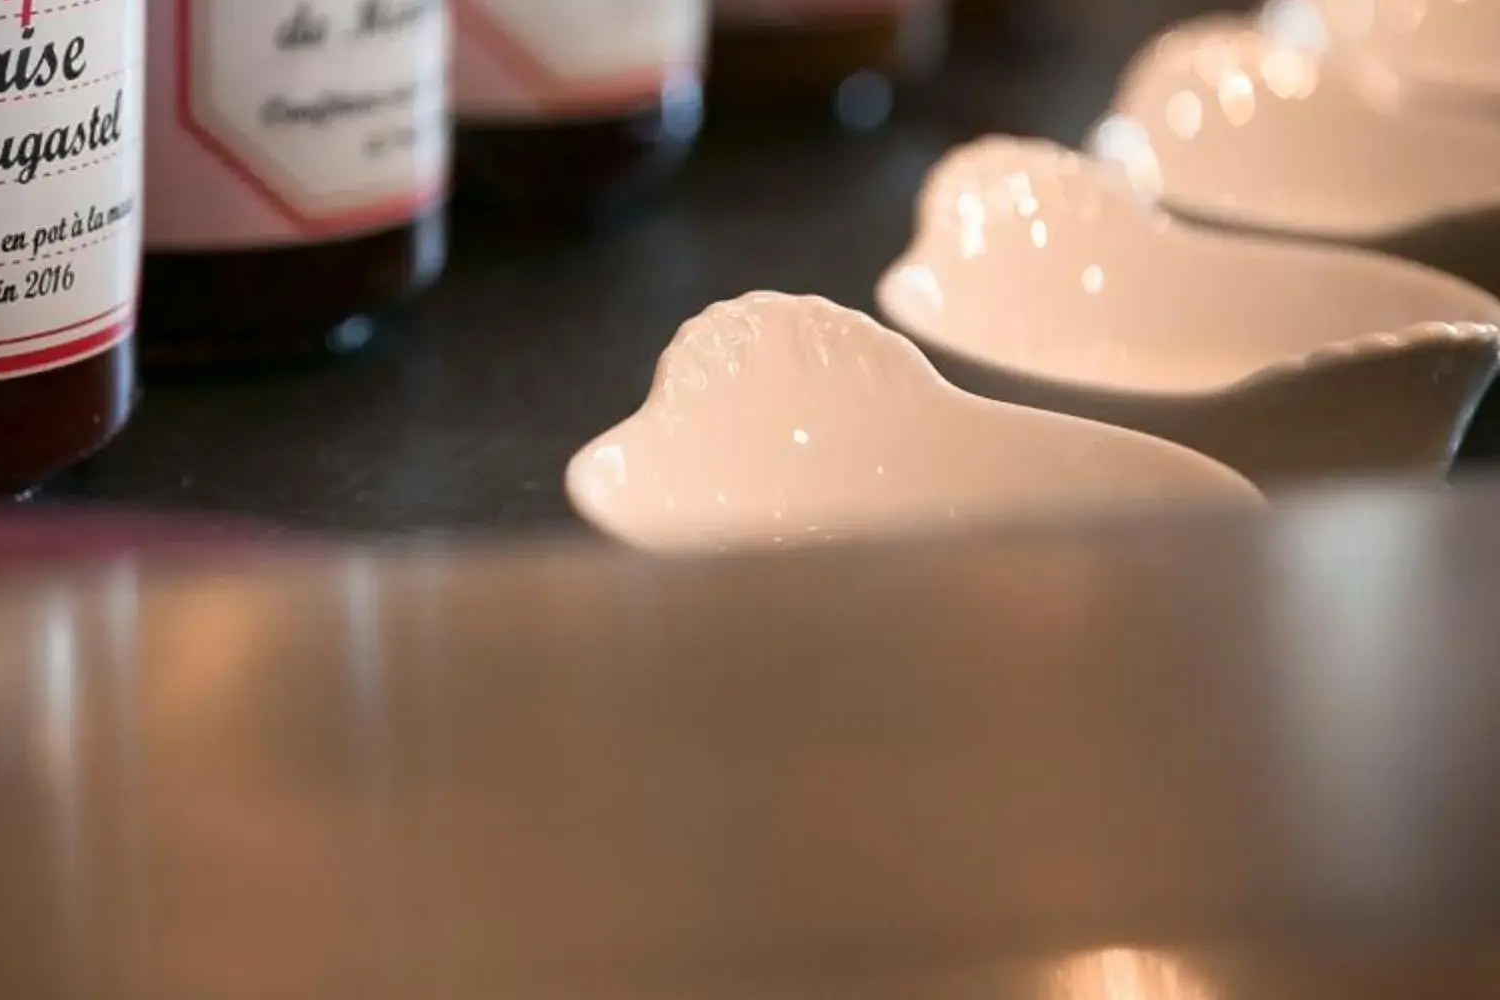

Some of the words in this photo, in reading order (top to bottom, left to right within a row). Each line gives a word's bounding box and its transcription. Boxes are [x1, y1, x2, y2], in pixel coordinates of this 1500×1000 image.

[2, 232, 26, 254] en
[33, 218, 67, 256] pot
[70, 210, 84, 237] à
[87, 204, 104, 232] la
[24, 263, 75, 300] 2016
